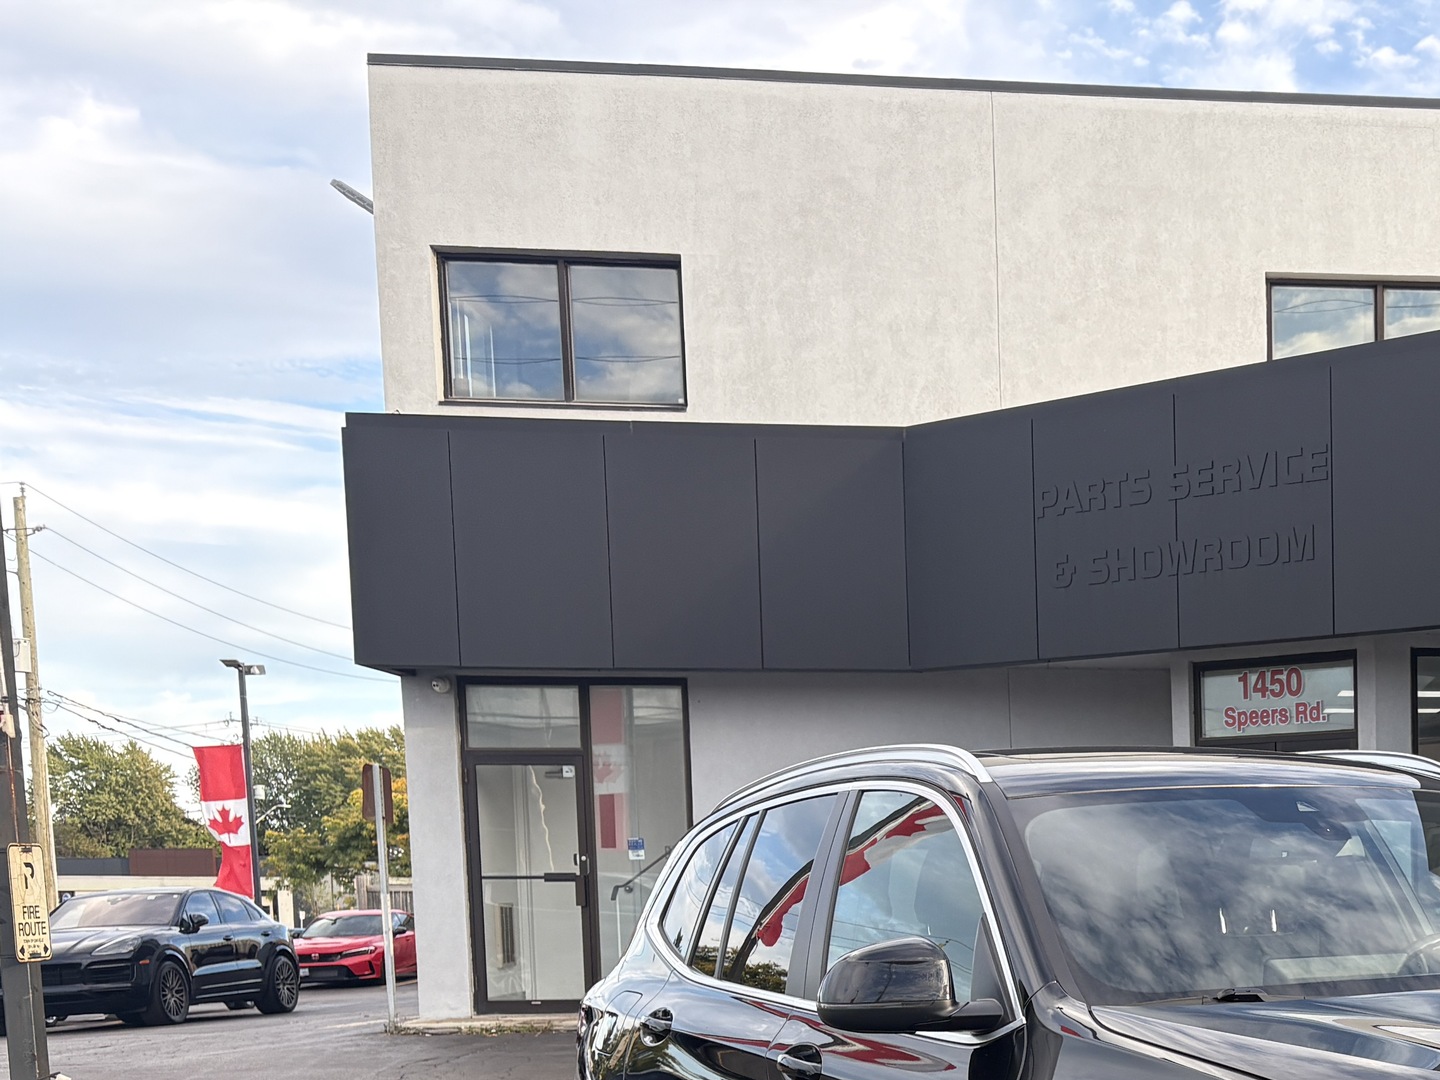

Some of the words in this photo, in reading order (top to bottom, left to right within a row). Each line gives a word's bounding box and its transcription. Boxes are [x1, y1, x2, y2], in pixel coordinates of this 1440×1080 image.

[1036, 468, 1153, 520] PARTS
[1167, 443, 1330, 502] SERVICE
[1053, 553, 1077, 589] &
[1086, 523, 1316, 587] SHOWROOM
[1237, 666, 1304, 701] 1450
[1223, 702, 1290, 732] Speers
[1294, 700, 1328, 724] Rd.
[18, 921, 47, 937] ROUTE
[22, 905, 41, 920] FIRE
